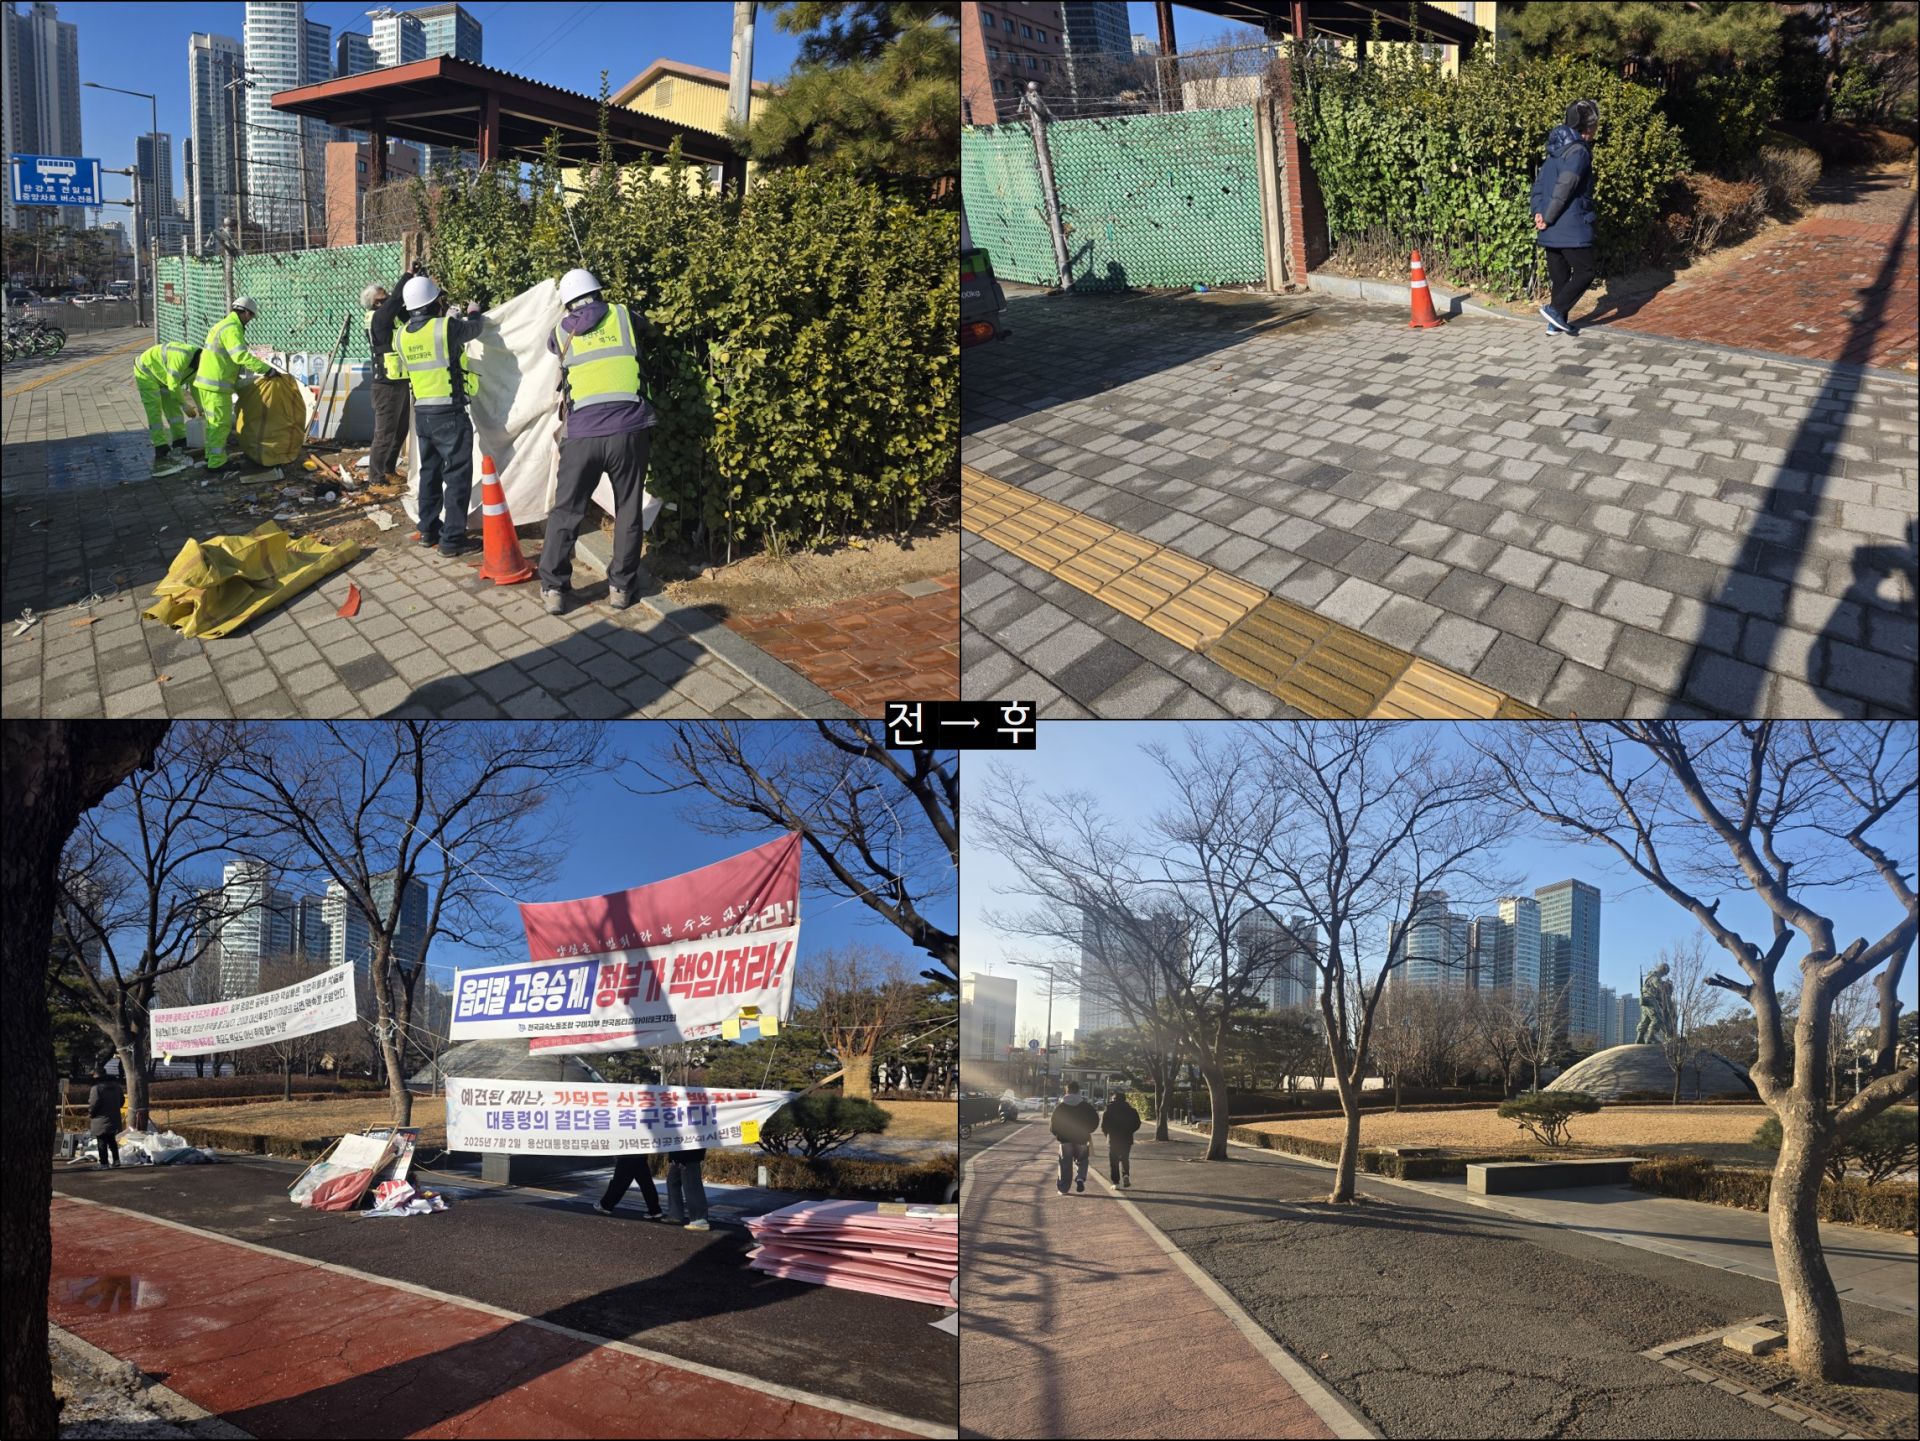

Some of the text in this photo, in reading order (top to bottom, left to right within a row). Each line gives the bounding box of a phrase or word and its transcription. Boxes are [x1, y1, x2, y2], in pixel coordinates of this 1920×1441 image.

[22, 193, 94, 203] 중앙차로 버스전용
[682, 915, 713, 934] 수는
[458, 942, 788, 1018] 옵티칼 고용승계, 정부가 책임져라!
[575, 1019, 600, 1029] 구미지부
[461, 1088, 504, 1106] 예견된
[506, 1088, 545, 1107] 재난,
[552, 1090, 609, 1107] 가덕도
[616, 1090, 679, 1108] 신공항
[486, 1105, 718, 1131] 대통령의 결단을 촉구한다!
[464, 1136, 492, 1147] 2025년
[493, 1136, 506, 1147] 7월
[508, 1137, 521, 1147] 2일
[527, 1138, 610, 1151] 용산대통령집무실앞
